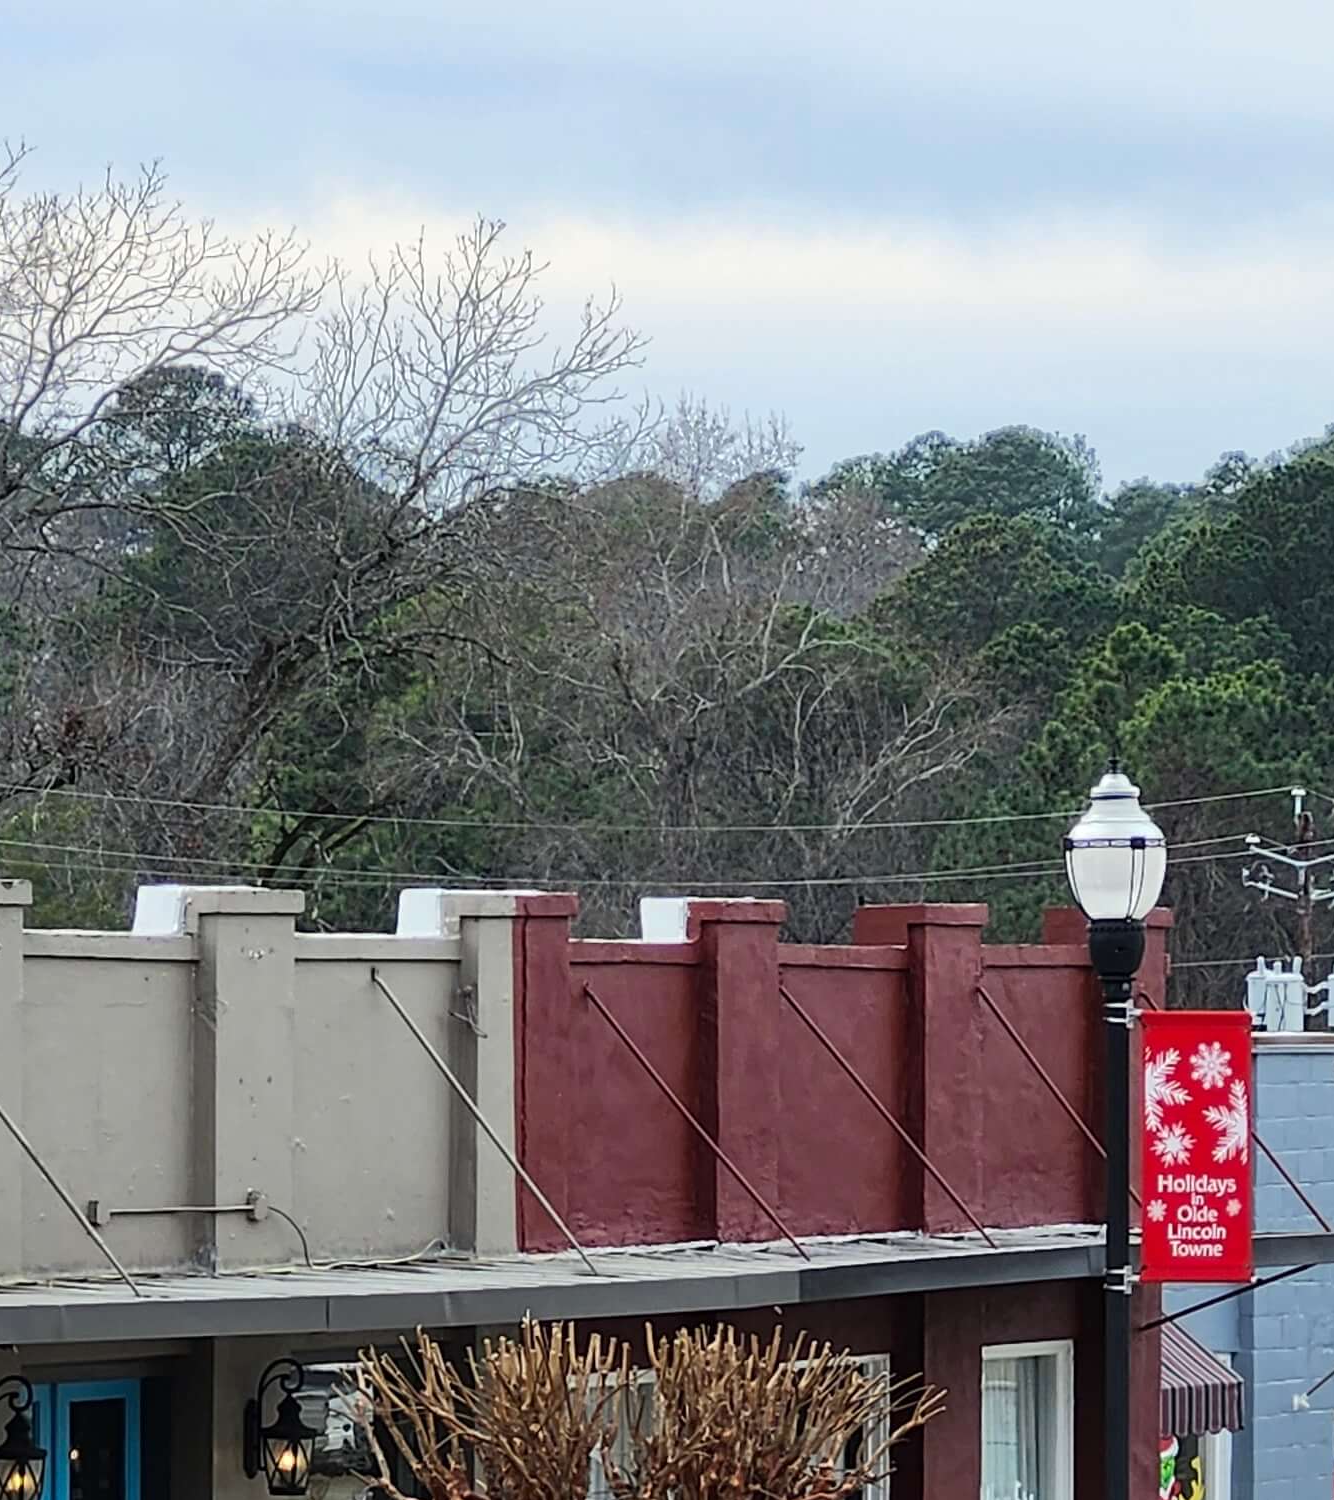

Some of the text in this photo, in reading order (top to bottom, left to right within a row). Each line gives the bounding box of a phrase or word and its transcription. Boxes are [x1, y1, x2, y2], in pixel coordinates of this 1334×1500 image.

[1157, 1173, 1237, 1198] Holidays
[1177, 1204, 1219, 1223] Olde
[1167, 1222, 1227, 1240] Lincoln
[1169, 1240, 1224, 1257] Towne
